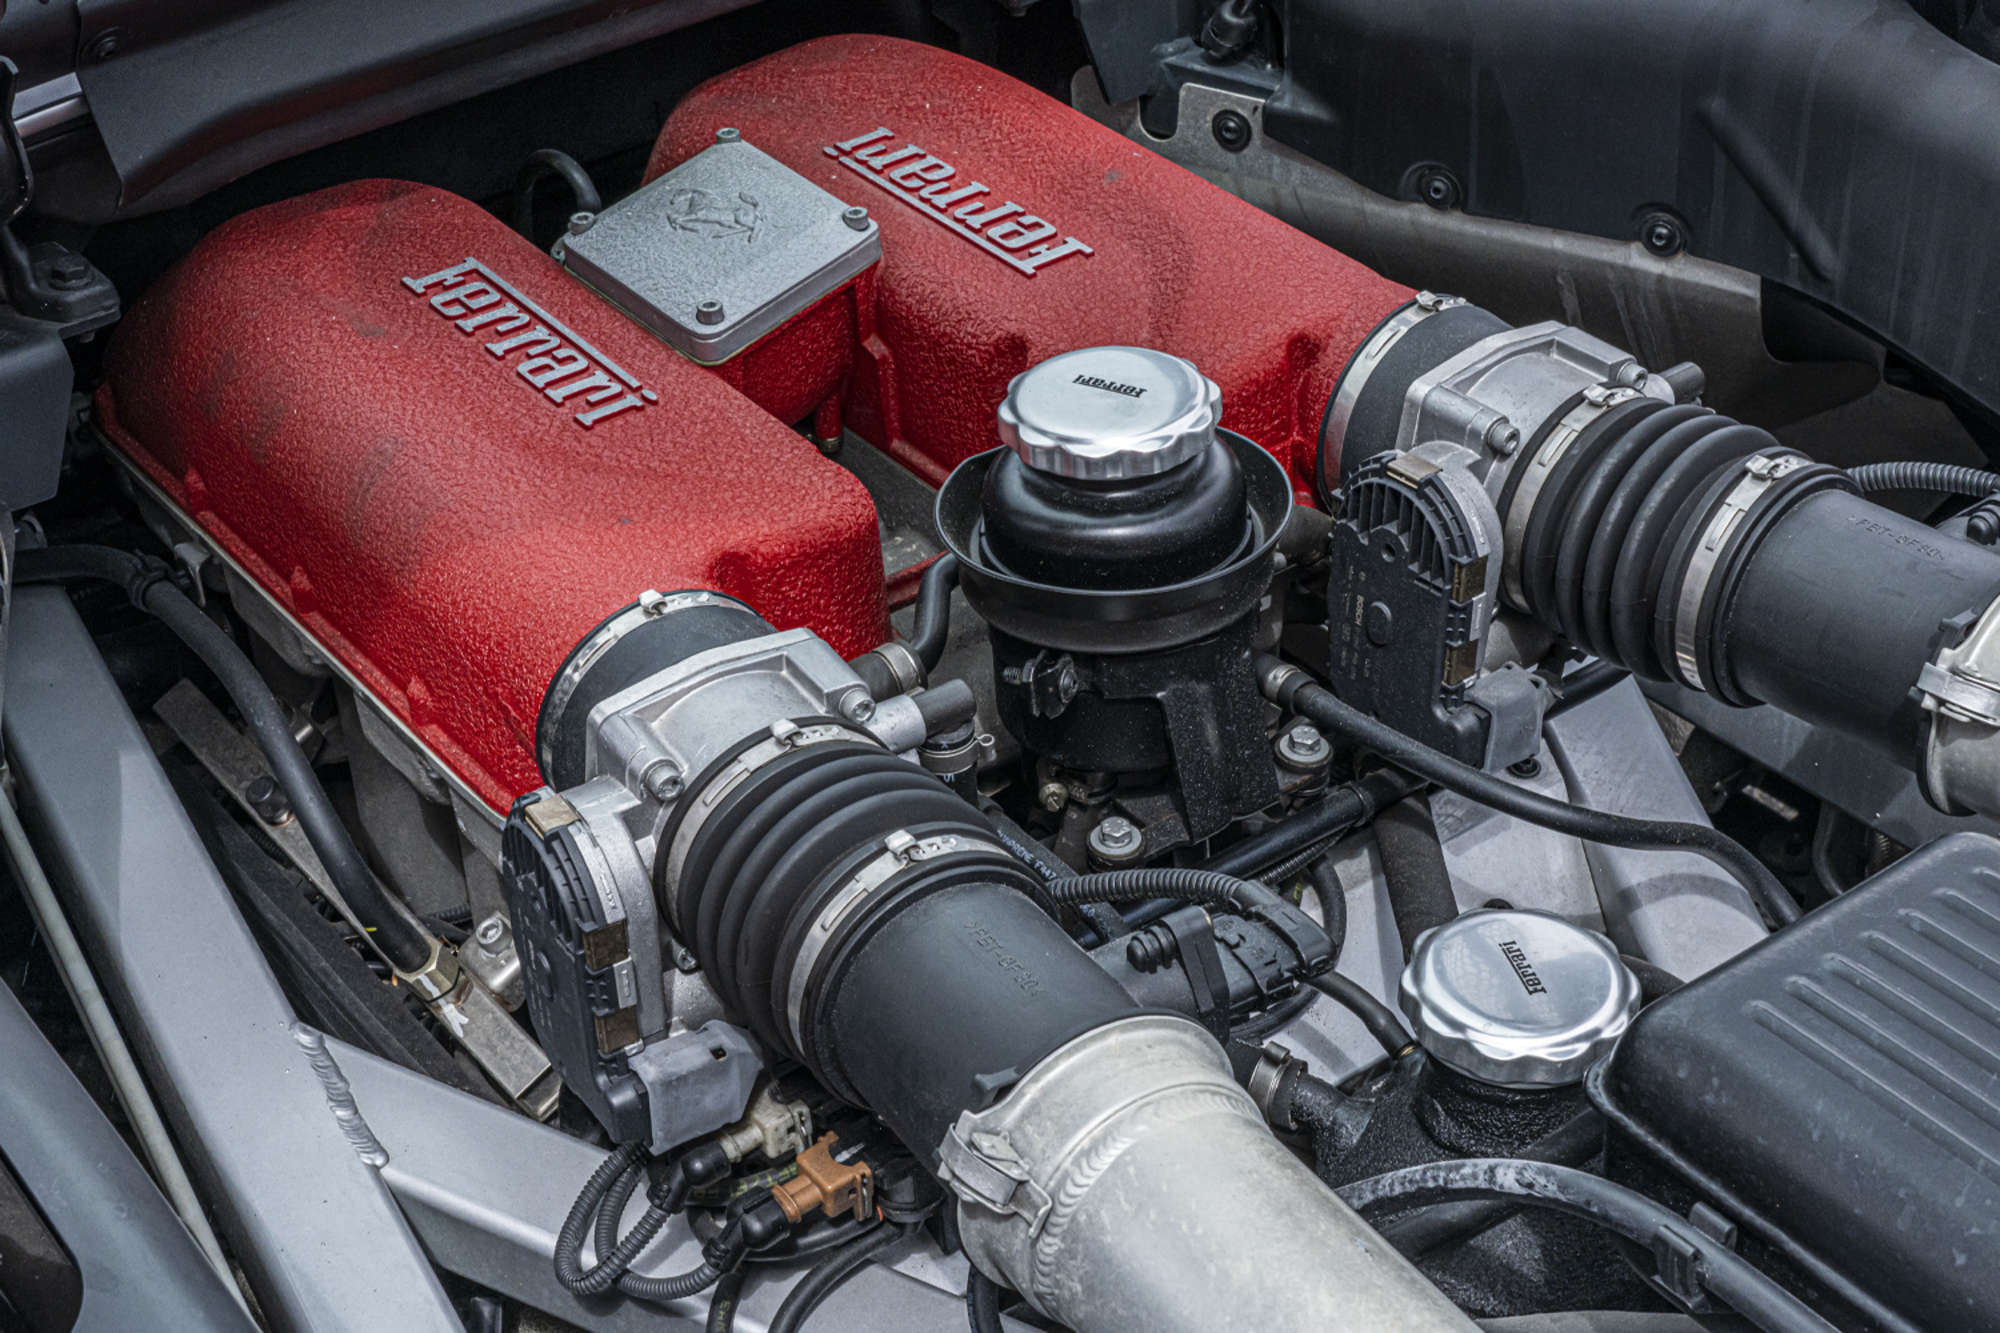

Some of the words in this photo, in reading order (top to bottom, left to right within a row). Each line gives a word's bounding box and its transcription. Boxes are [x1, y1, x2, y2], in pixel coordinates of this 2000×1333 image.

[823, 126, 1095, 277] Ferrari
[401, 256, 658, 428] Ferrari
[1072, 374, 1148, 398] Ferrari
[1355, 594, 1364, 626] BOSCH
[1498, 940, 1548, 996] Ferrari
